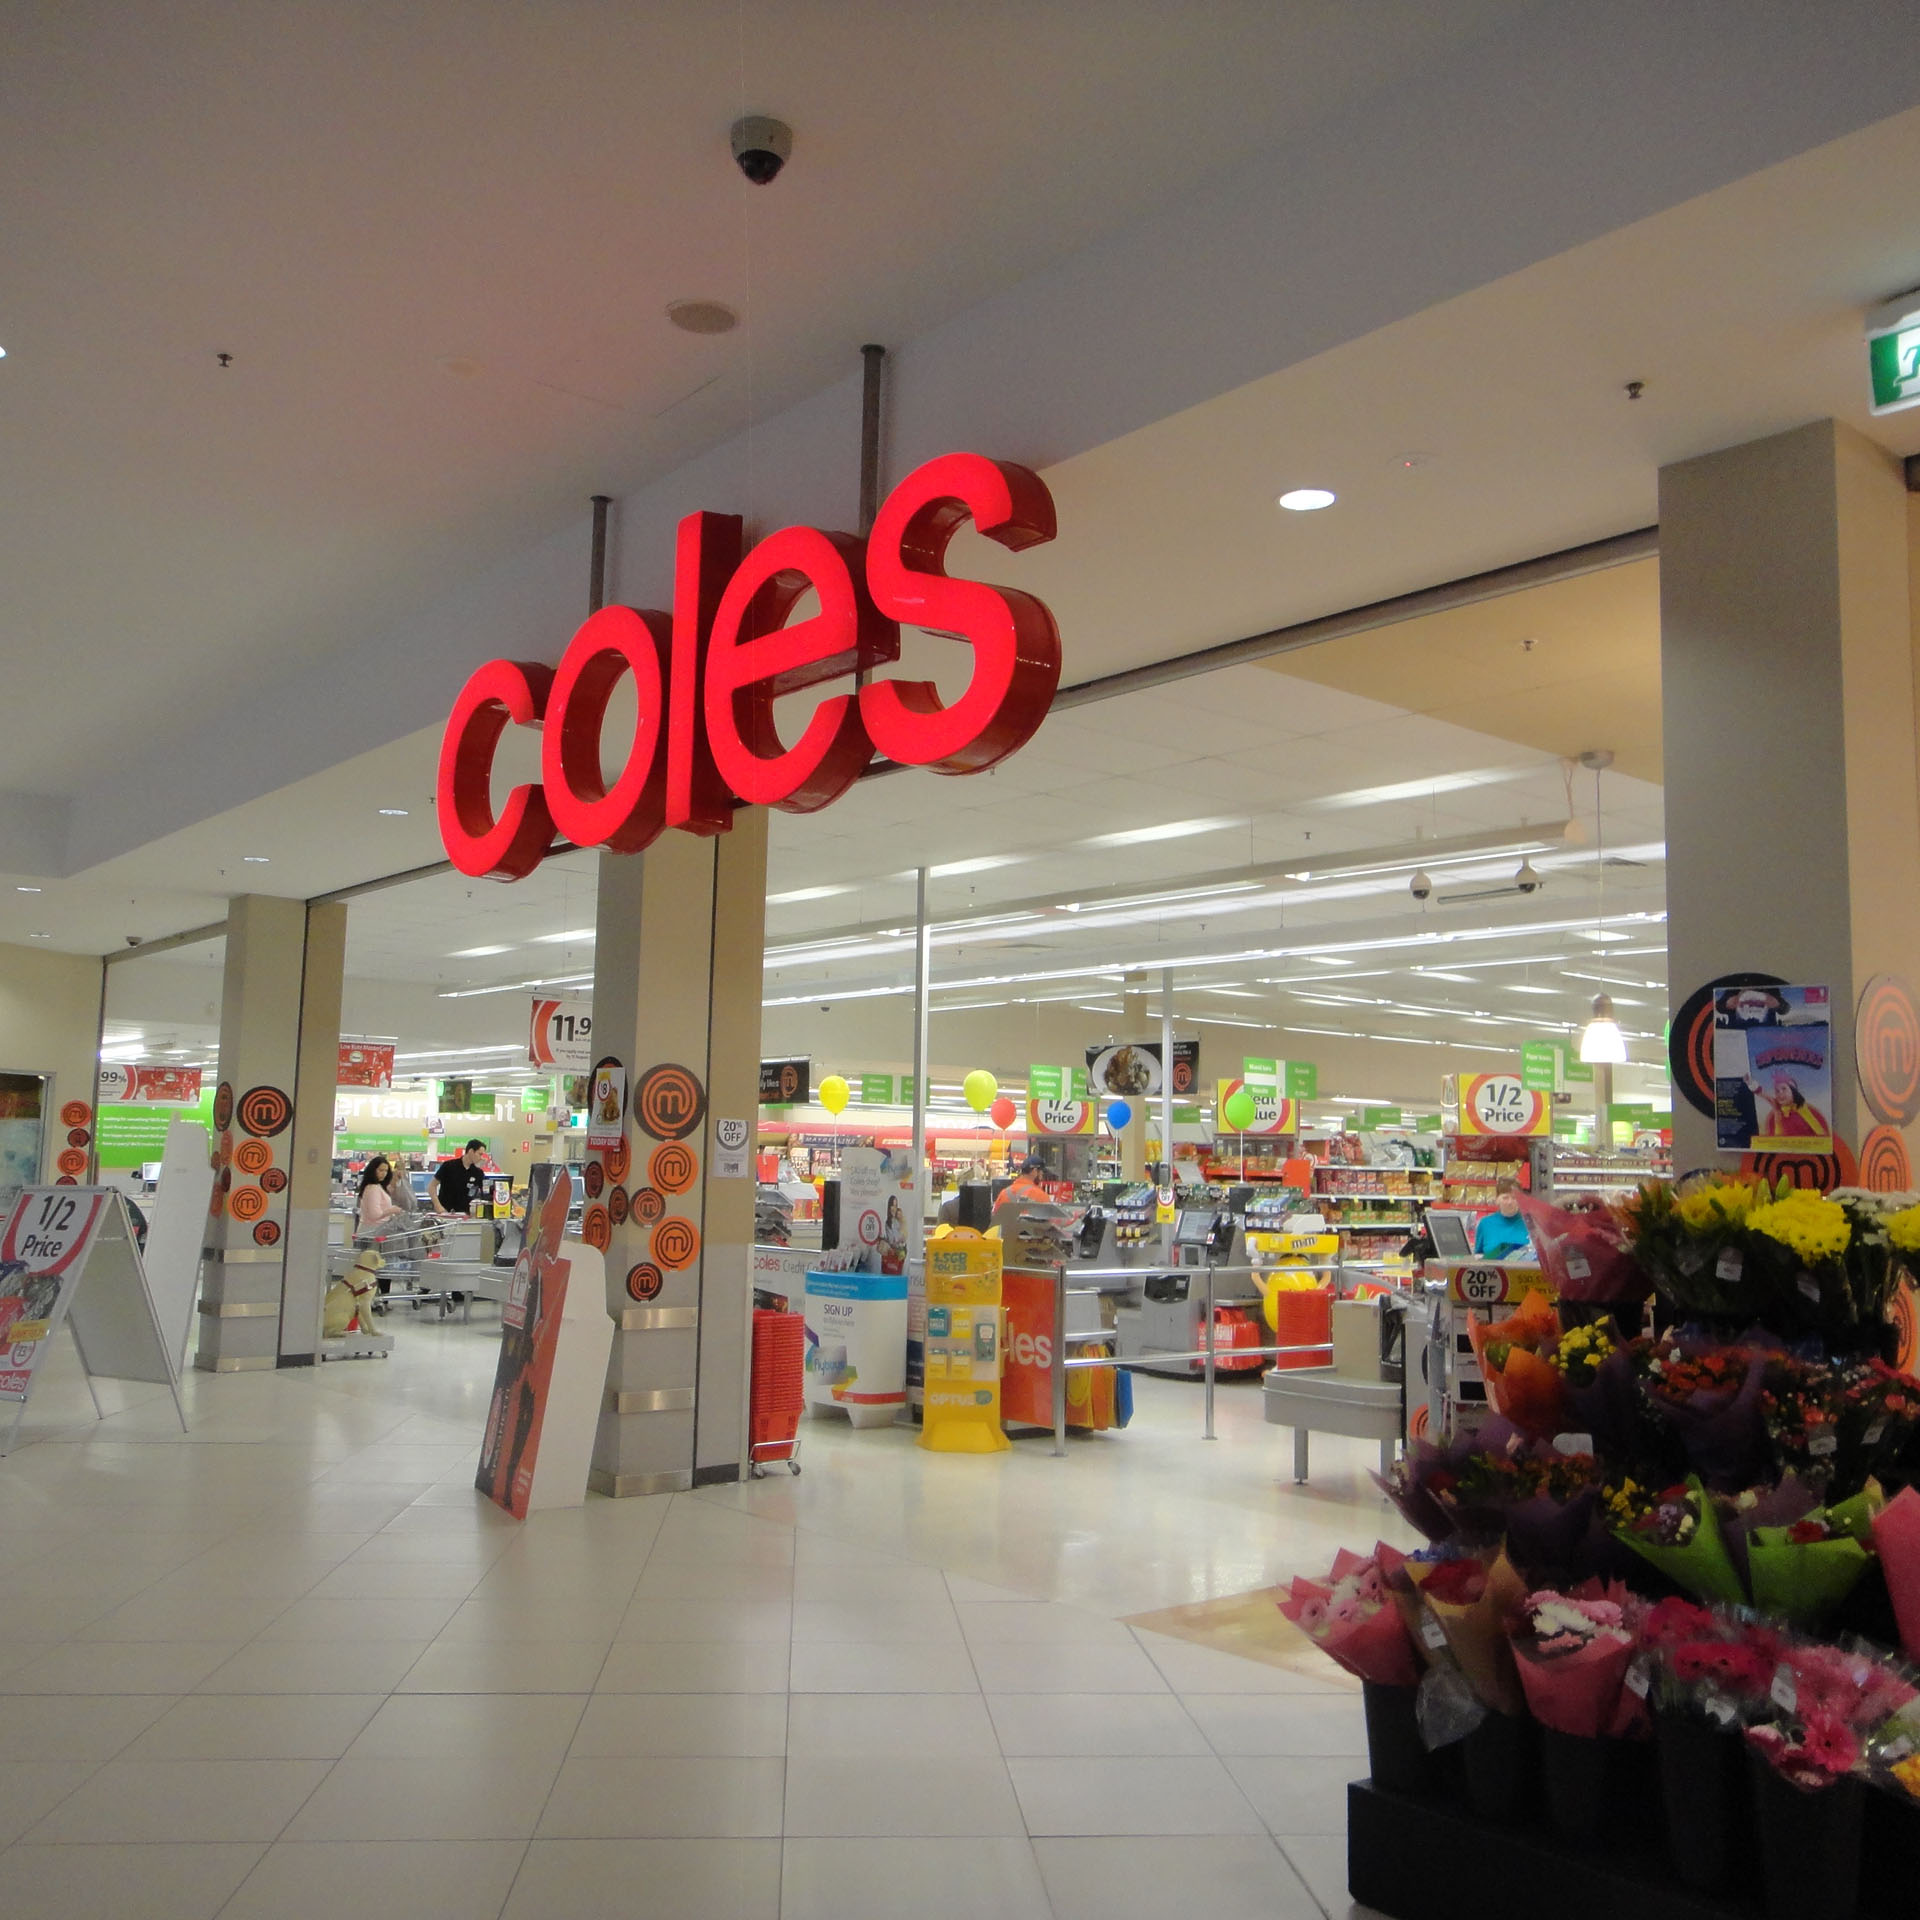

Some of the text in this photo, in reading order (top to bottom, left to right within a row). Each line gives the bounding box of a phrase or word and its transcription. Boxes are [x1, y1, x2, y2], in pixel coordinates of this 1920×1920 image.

[438, 452, 1050, 880] coles
[1252, 1095, 1277, 1106] eat
[1486, 1083, 1522, 1107] 1/2
[1045, 1112, 1075, 1124] Price
[1254, 1107, 1277, 1121] lue
[1485, 1108, 1524, 1122] Price
[723, 1121, 743, 1132] 20%
[724, 1132, 742, 1142] OFF
[804, 1135, 857, 1145] MAYBELLINE
[39, 1195, 76, 1232] 1/2
[20, 1234, 62, 1258] Price
[754, 1255, 780, 1270] coles
[1467, 1270, 1498, 1284] 20%
[1469, 1285, 1496, 1298] OFF
[824, 1304, 853, 1317] SIGN UP
